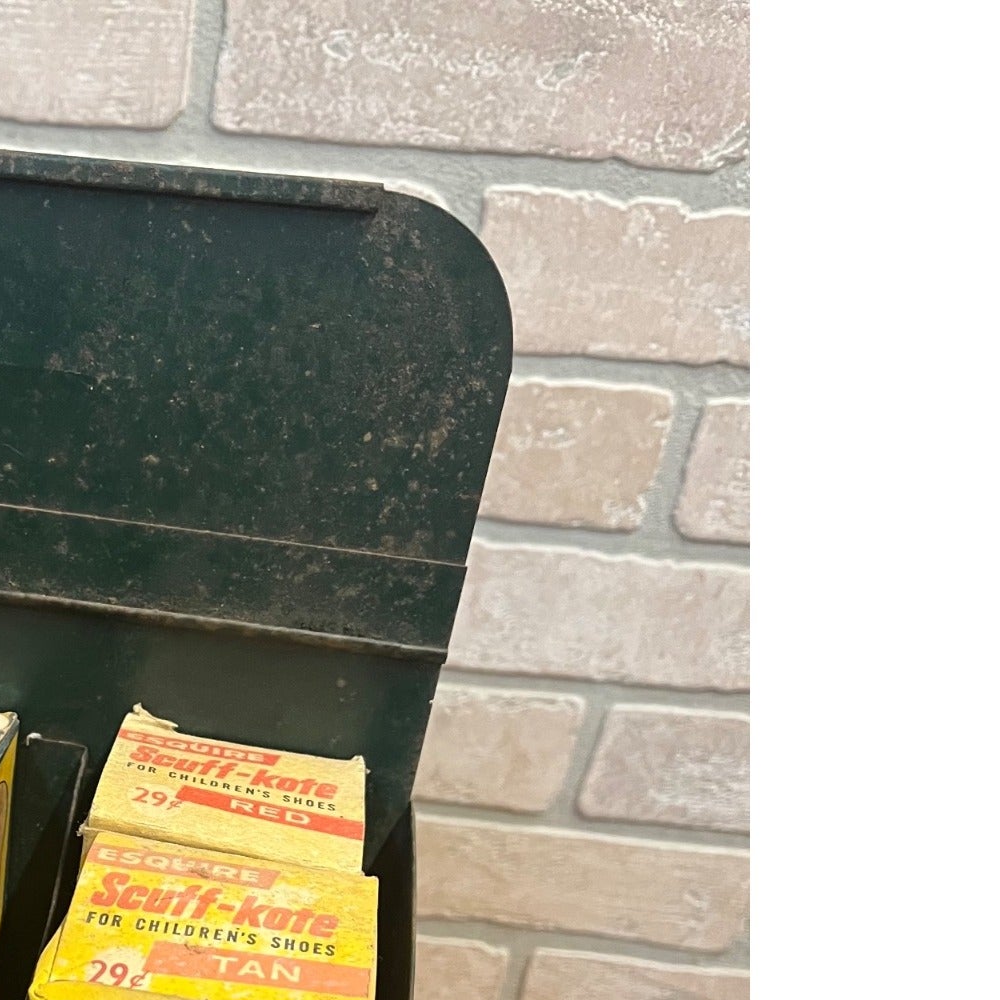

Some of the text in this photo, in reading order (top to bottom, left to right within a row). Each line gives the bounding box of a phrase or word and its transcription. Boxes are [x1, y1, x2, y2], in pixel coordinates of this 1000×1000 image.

[126, 731, 267, 762] ESQUIRE
[126, 761, 336, 812] FOR CHILDREN'S SHOES
[128, 745, 339, 799] Scuff-kote
[131, 787, 182, 811] 29¢
[230, 797, 312, 825] RED
[97, 847, 260, 883] ESQUIRE
[91, 872, 339, 939] Scuff-kote
[86, 911, 336, 957] FOR CHILDREN'S SHOES
[212, 955, 301, 982] TAN
